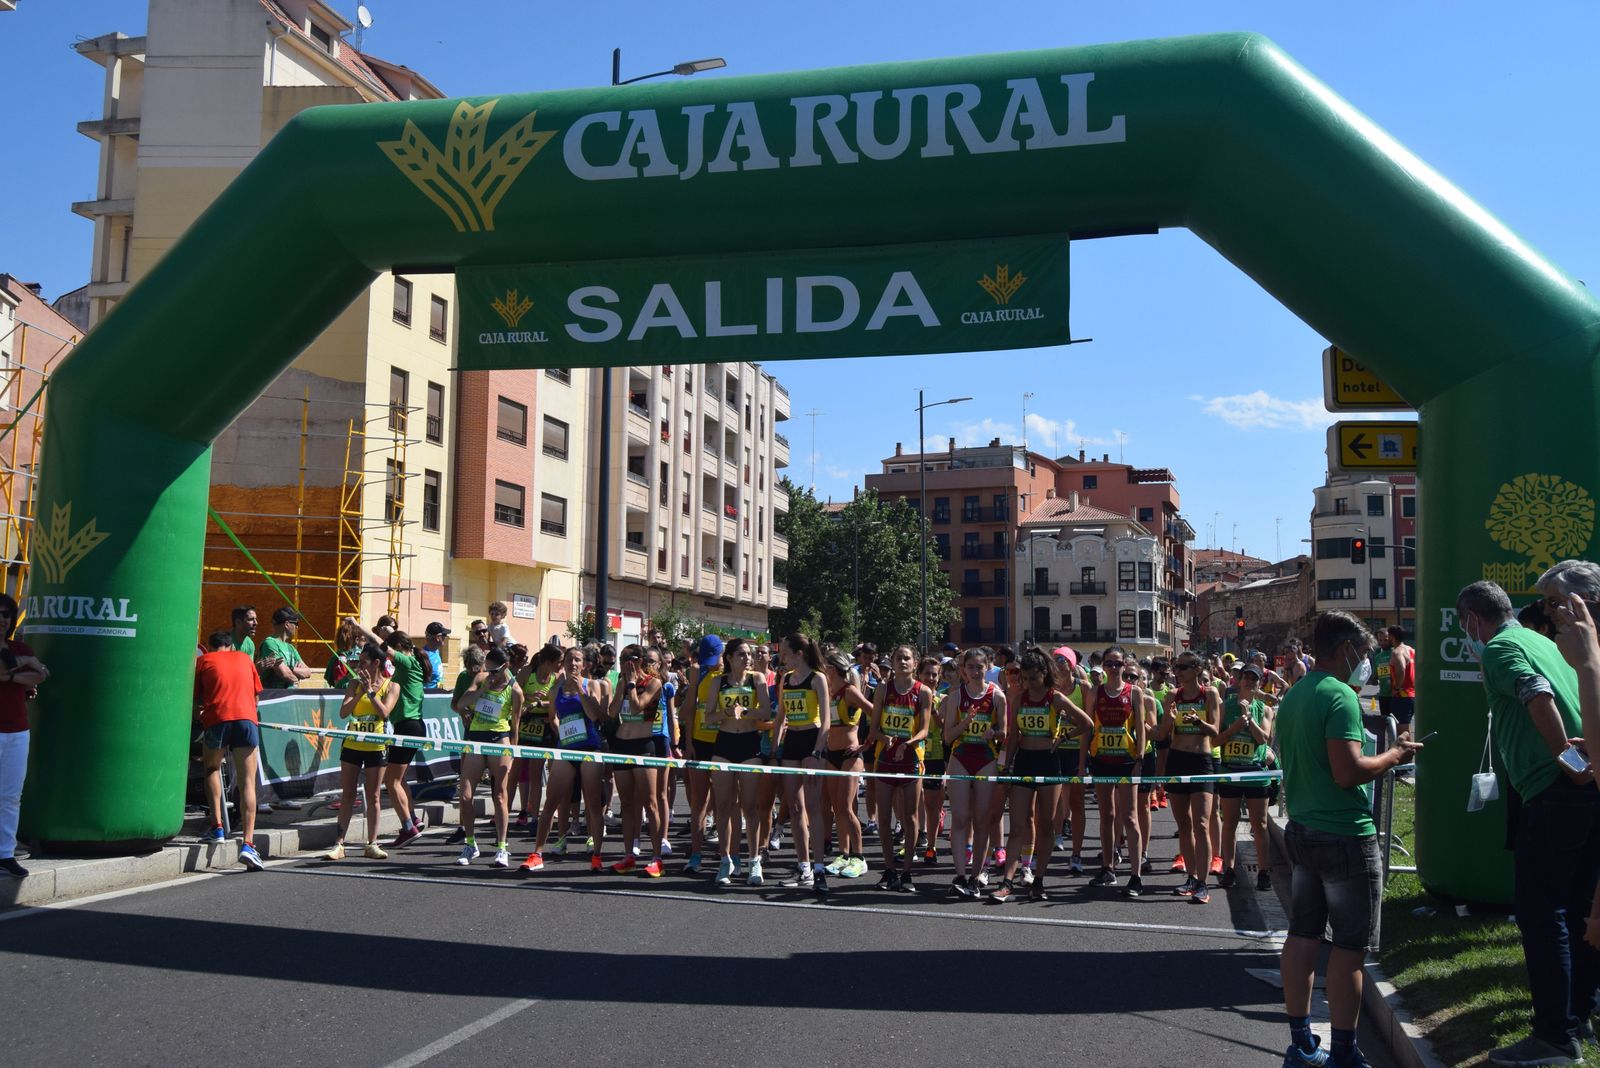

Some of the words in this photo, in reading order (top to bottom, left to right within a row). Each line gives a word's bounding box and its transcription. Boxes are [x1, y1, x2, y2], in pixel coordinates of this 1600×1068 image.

[562, 101, 780, 181] CAJA
[790, 72, 1127, 168] RURAL
[564, 270, 942, 343] SALIDA
[960, 312, 995, 324] CAJA
[996, 307, 1045, 322] RURAL
[479, 332, 506, 344] CAJA
[507, 331, 549, 343] RURAL
[1342, 381, 1381, 393] hotel
[41, 595, 138, 622] RURAL
[97, 628, 127, 636] ZAMORA
[724, 695, 750, 708] 248
[353, 722, 375, 733] 160
[522, 721, 543, 735] 209
[884, 715, 910, 729] 402
[1020, 715, 1045, 729] 136
[1100, 735, 1123, 747] 107
[1227, 743, 1250, 755] 150
